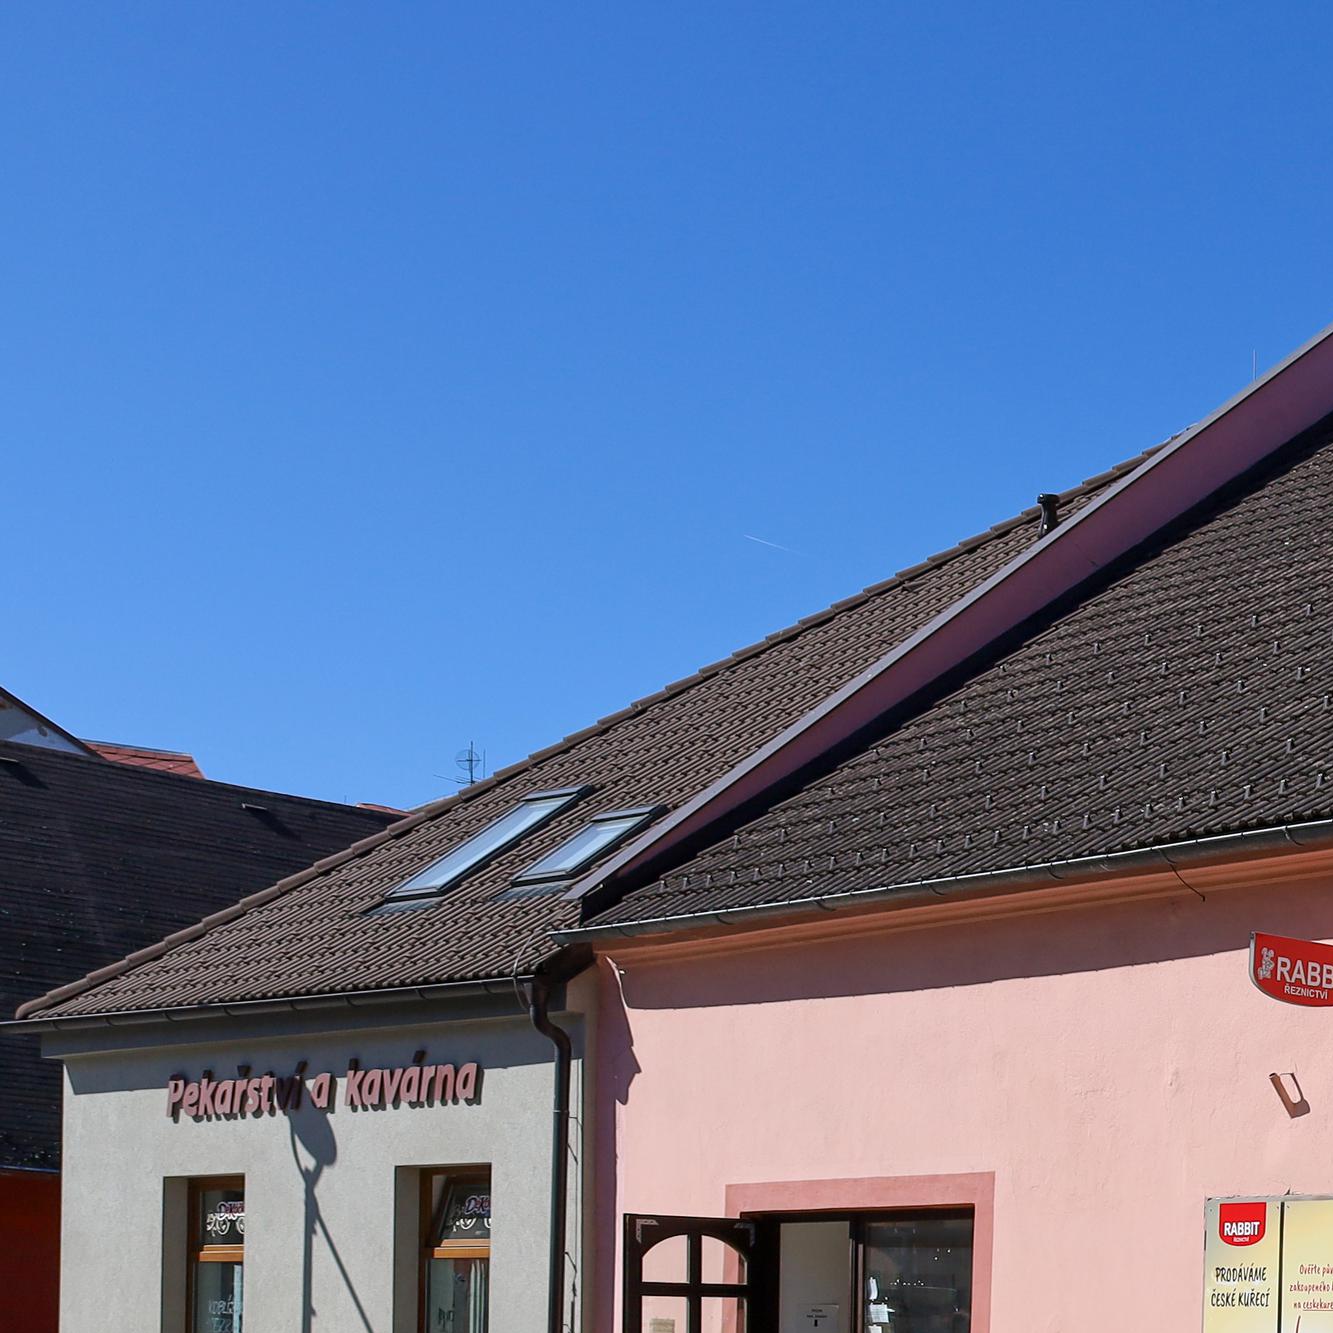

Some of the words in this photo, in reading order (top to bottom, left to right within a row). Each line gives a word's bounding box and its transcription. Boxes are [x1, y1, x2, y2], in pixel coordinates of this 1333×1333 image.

[1284, 984, 1328, 1000] ŘEZNICTVÍ
[166, 1060, 308, 1119] Pekařství
[310, 1071, 333, 1109] a
[344, 1050, 480, 1108] kavárna
[1224, 1221, 1260, 1236] RABBIT
[1215, 1262, 1267, 1283] PRODÁVÁME
[1299, 1264, 1321, 1275] Ověřte
[1290, 1281, 1331, 1295] zakoupeného
[1210, 1287, 1236, 1308] ČESKÉ
[1238, 1287, 1271, 1308] KUŘECÍ
